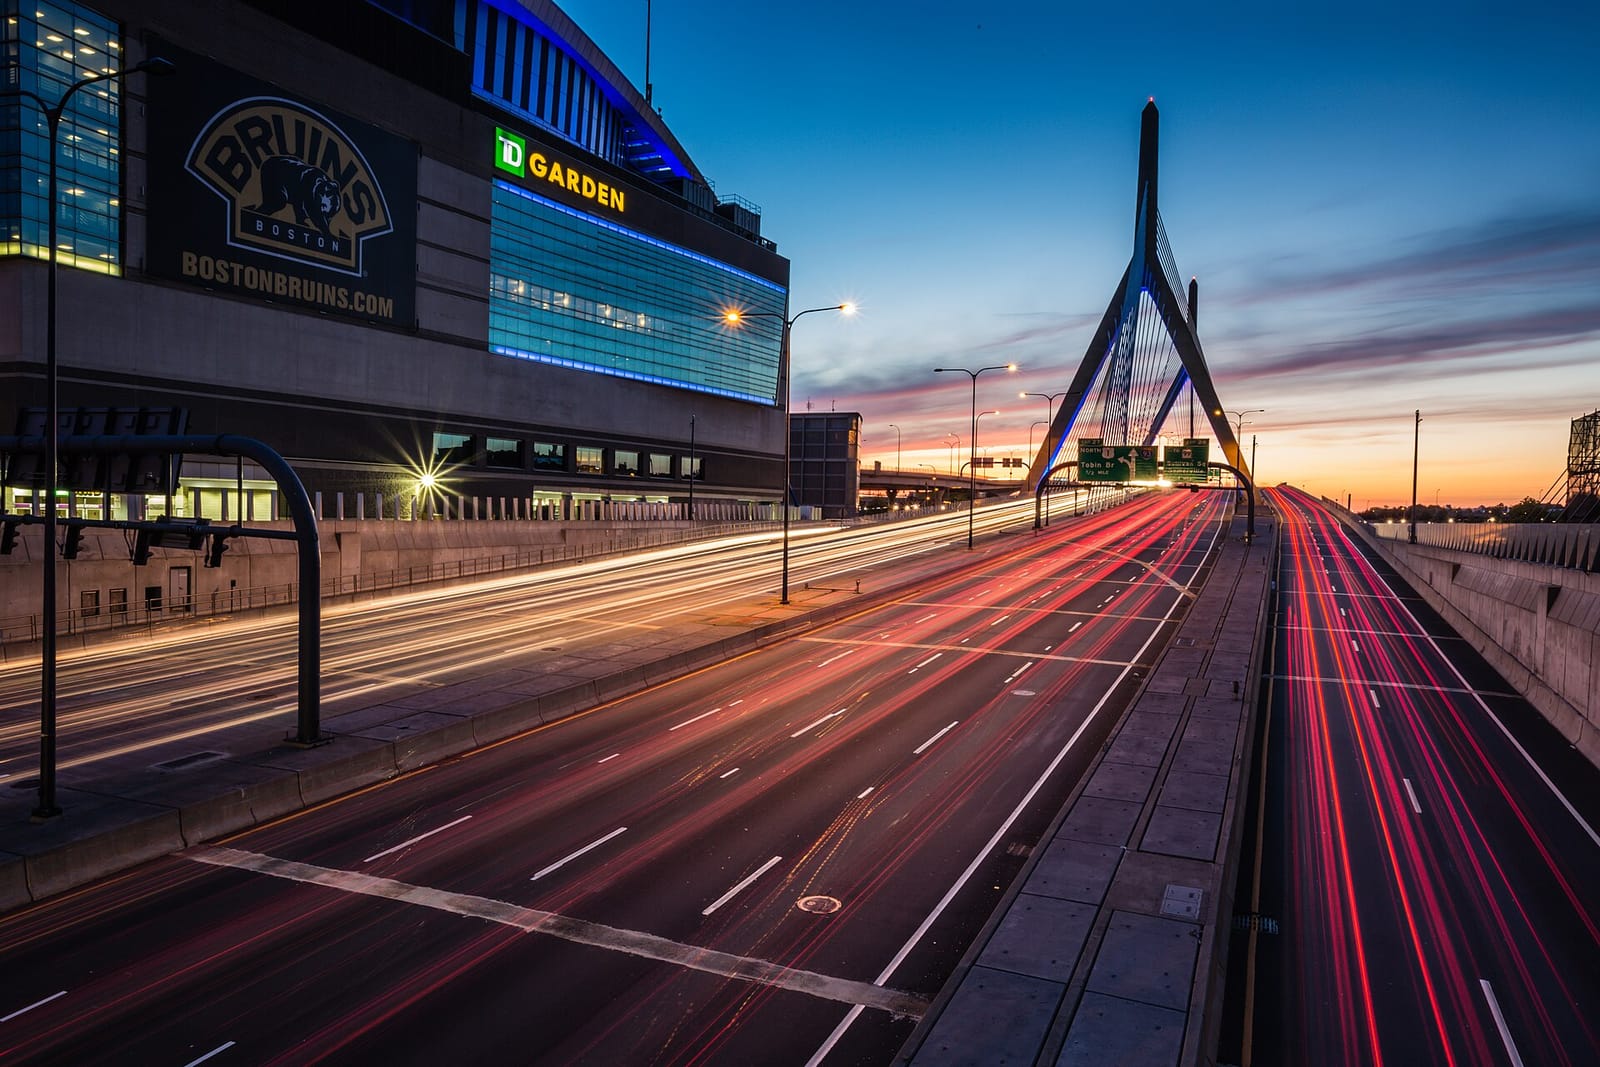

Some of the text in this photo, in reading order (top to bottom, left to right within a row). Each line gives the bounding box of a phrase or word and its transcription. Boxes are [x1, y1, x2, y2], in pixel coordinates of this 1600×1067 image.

[205, 114, 376, 225] BRUINS
[499, 136, 625, 212] TD GARDEN
[256, 219, 340, 252] BOSTON
[182, 251, 393, 318] BOSTONBRUINS.COM
[1080, 461, 1115, 469] Tobin Br
